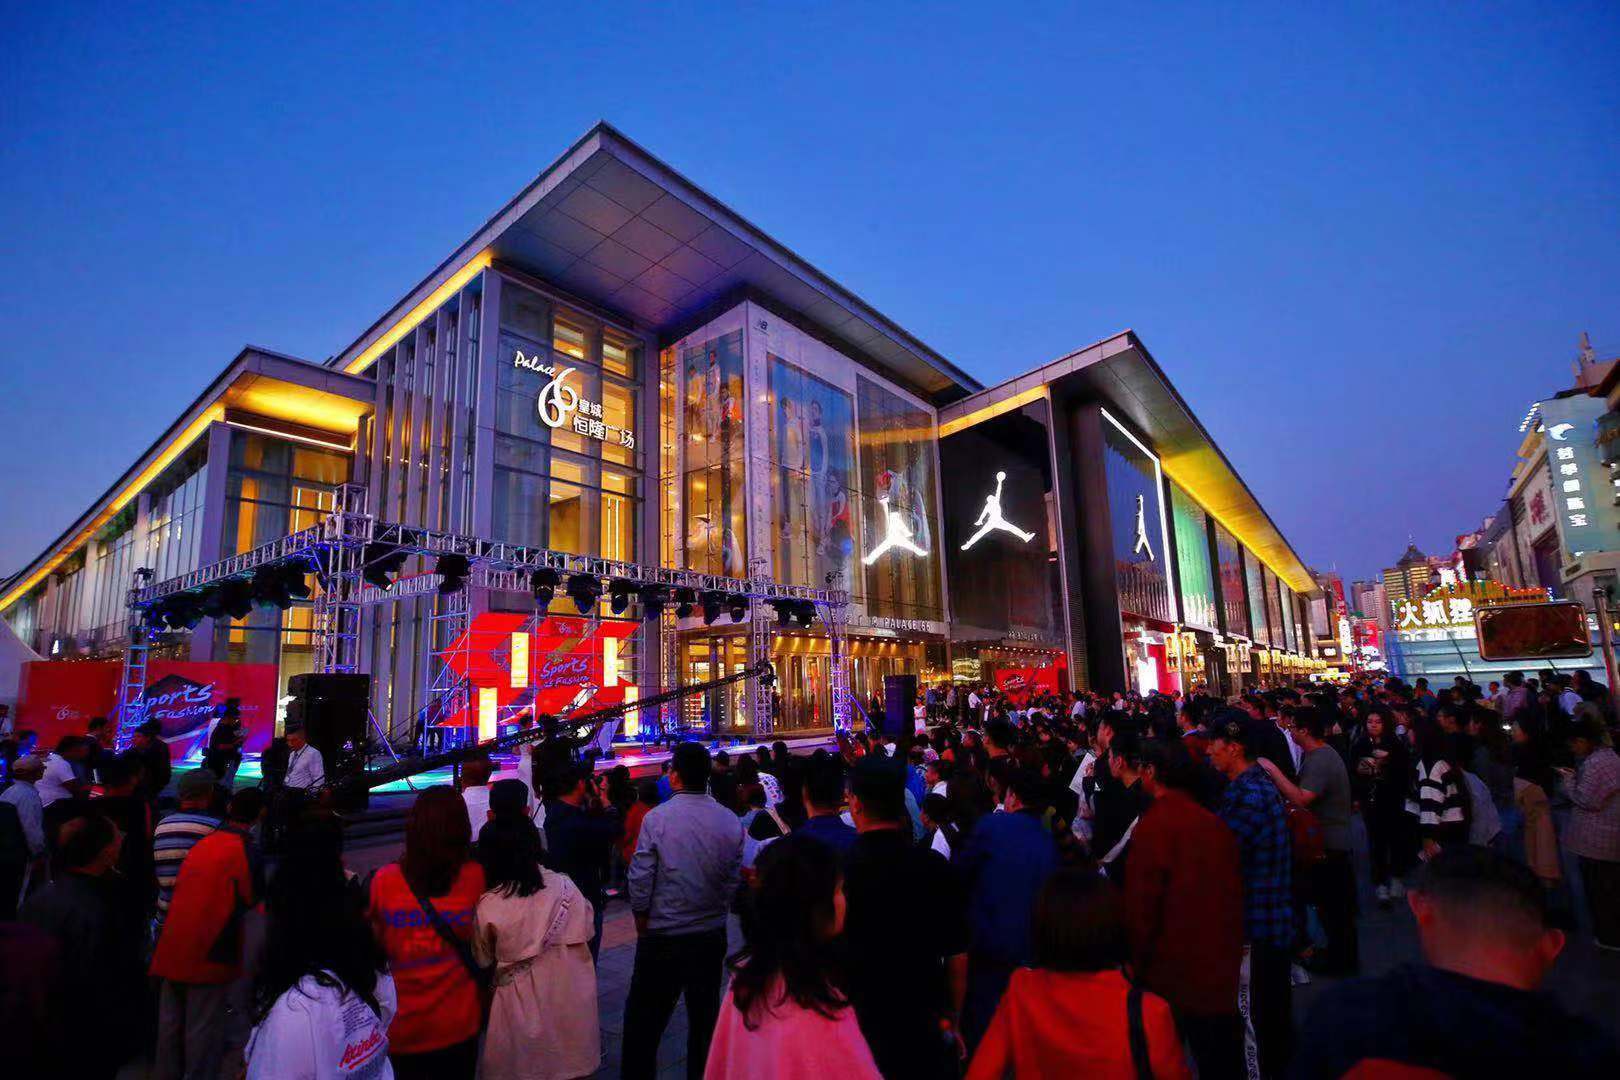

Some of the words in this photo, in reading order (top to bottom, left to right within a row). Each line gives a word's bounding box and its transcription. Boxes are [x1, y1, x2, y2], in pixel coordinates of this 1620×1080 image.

[514, 350, 556, 376] Palace
[578, 399, 602, 418] 皇城
[573, 414, 635, 449] 恒隆广场
[540, 657, 588, 679] Sports
[155, 705, 215, 719] Fashion
